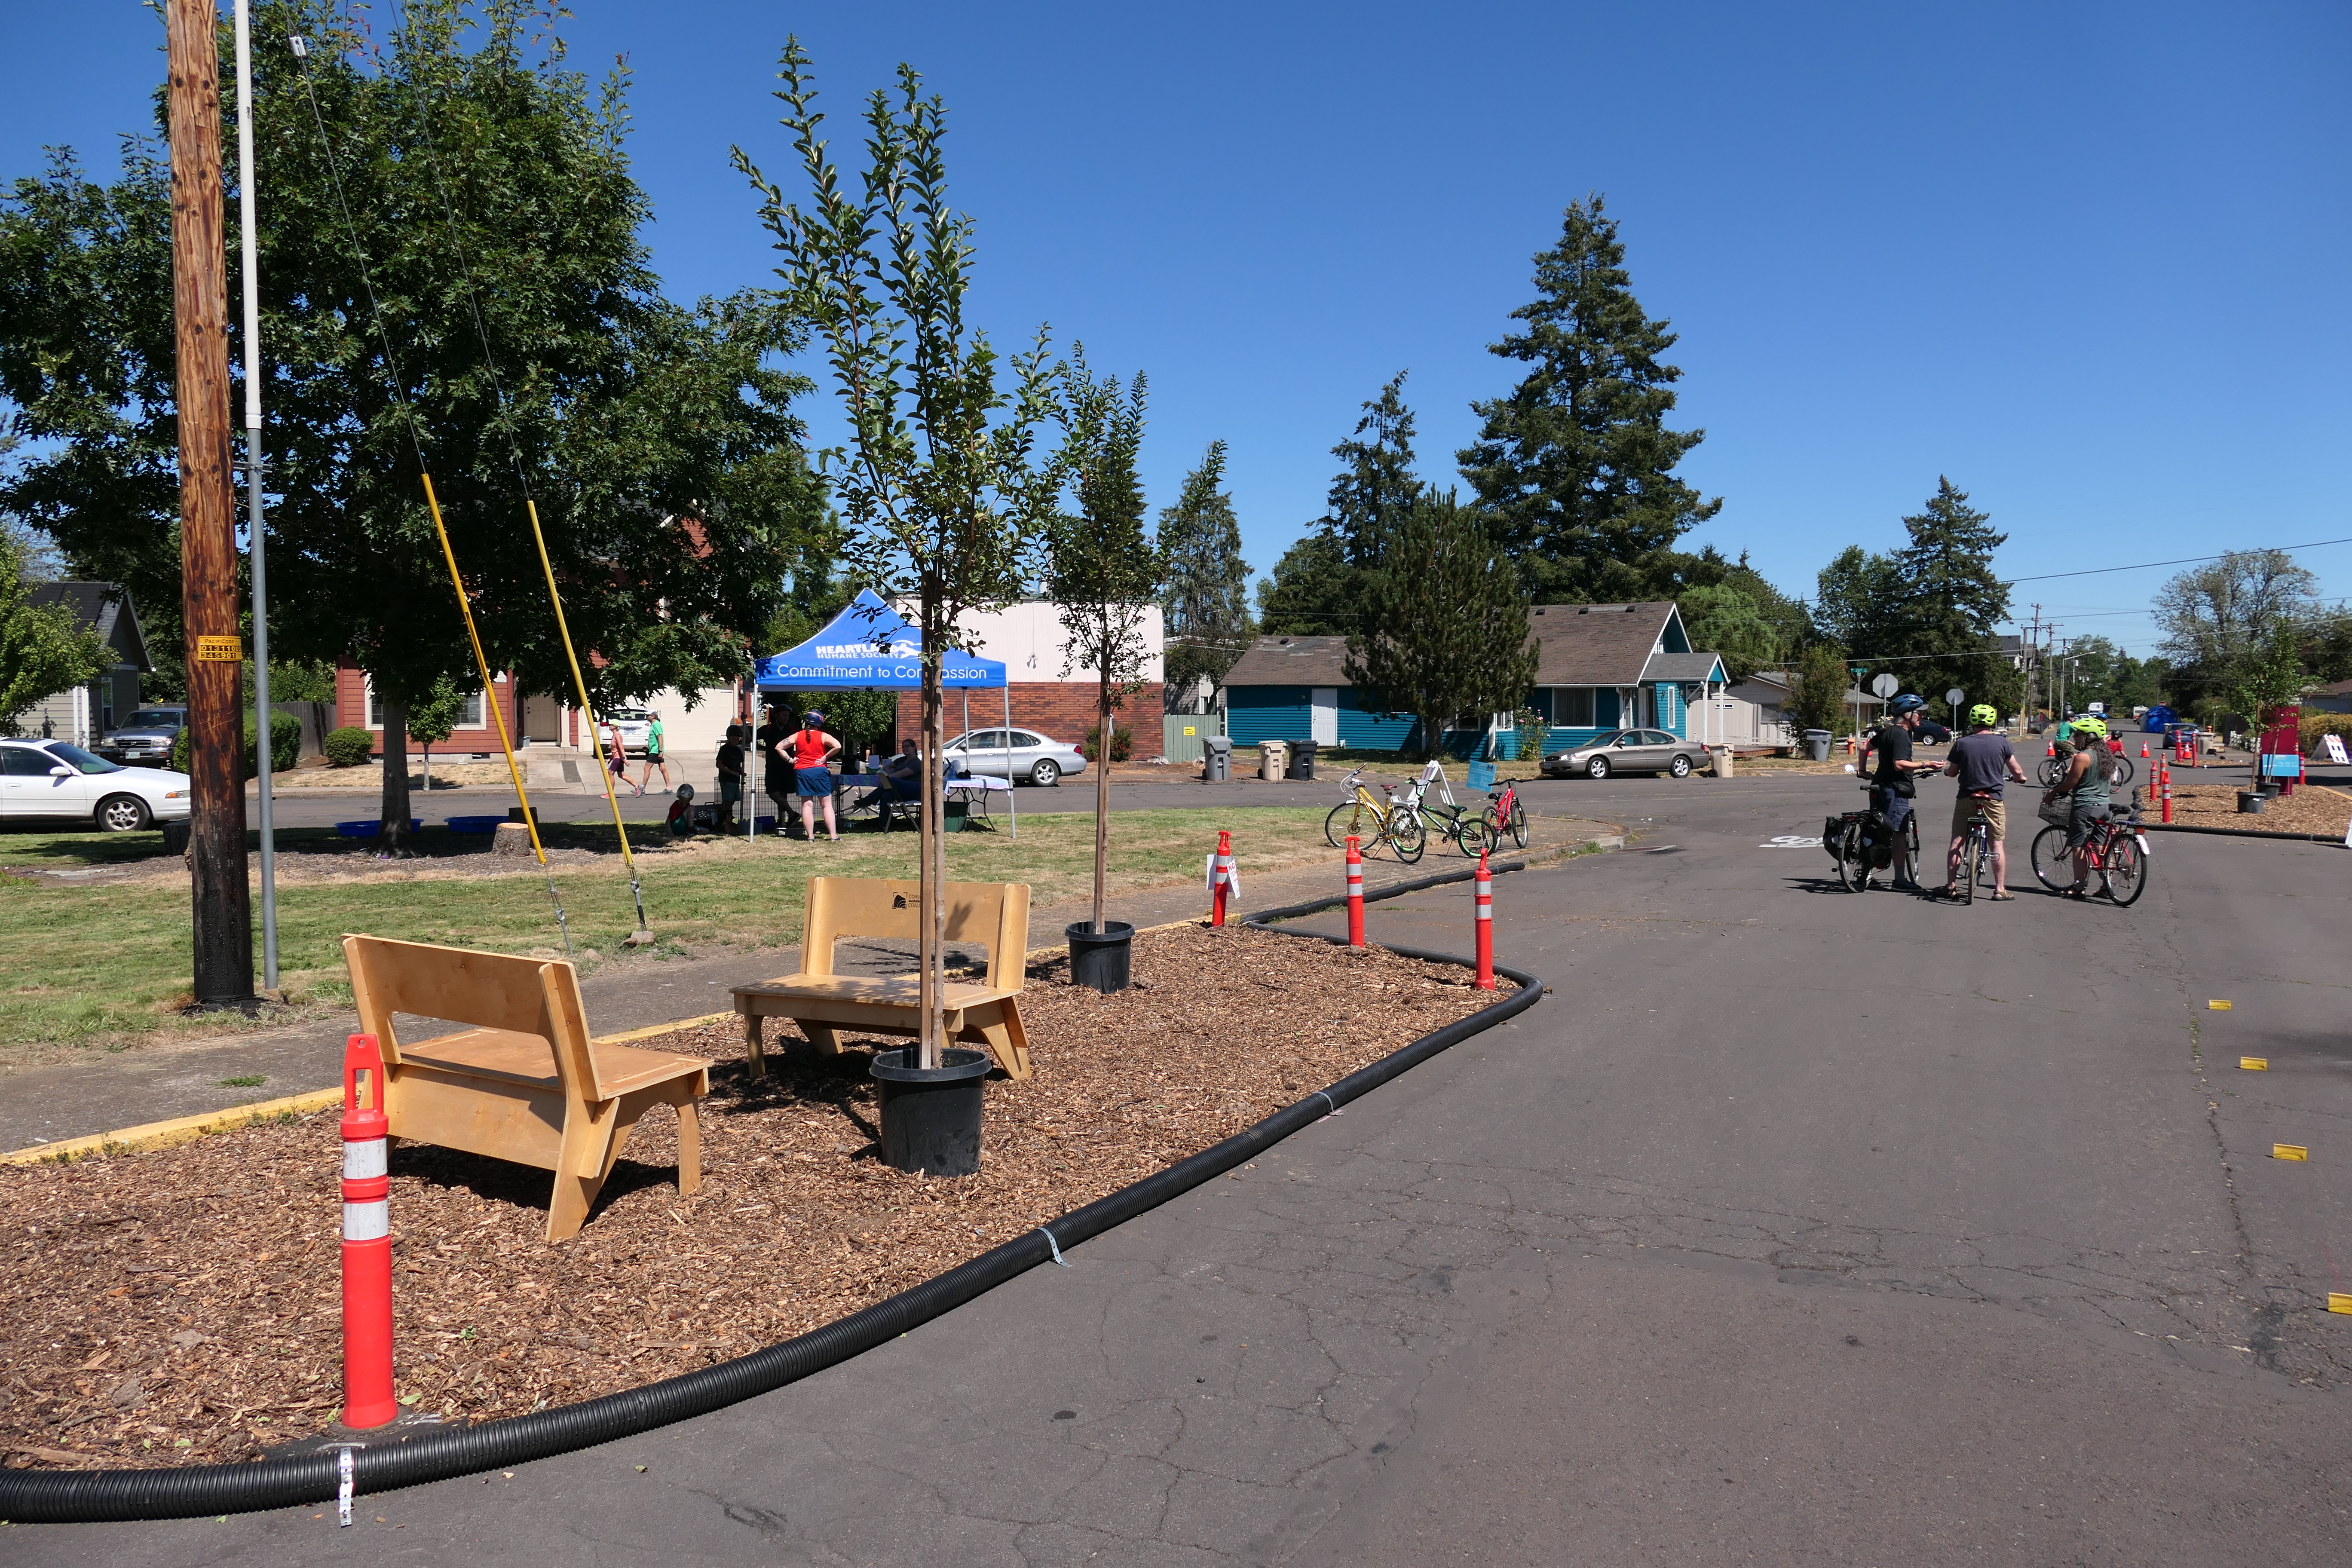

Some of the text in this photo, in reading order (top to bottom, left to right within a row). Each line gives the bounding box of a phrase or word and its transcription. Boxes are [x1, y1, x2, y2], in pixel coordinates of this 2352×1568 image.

[816, 643, 899, 654] HEARTLAD
[777, 664, 987, 679] Commitment to Coassion
[1228, 862, 1235, 871] NO
